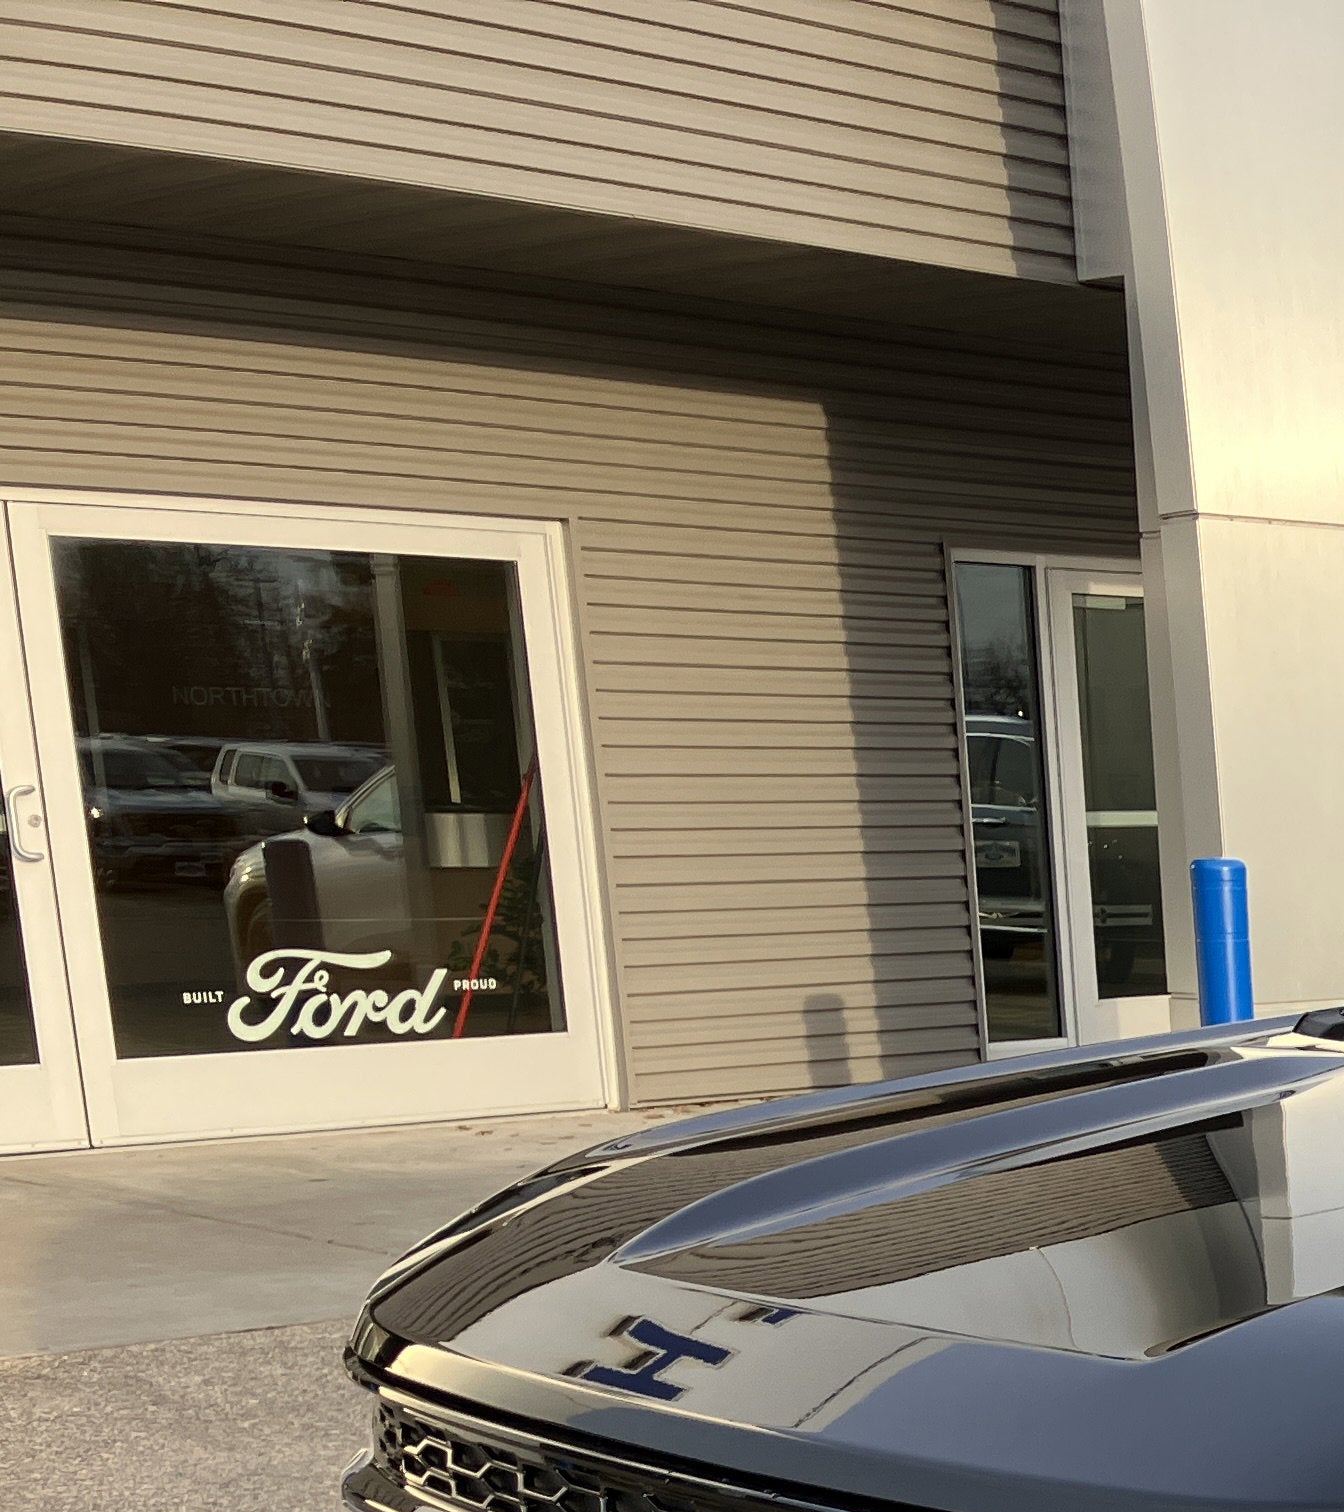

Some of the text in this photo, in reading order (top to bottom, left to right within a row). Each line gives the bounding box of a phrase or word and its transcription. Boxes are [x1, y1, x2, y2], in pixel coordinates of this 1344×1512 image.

[183, 949, 497, 1042] BUILT Ford PROUD
